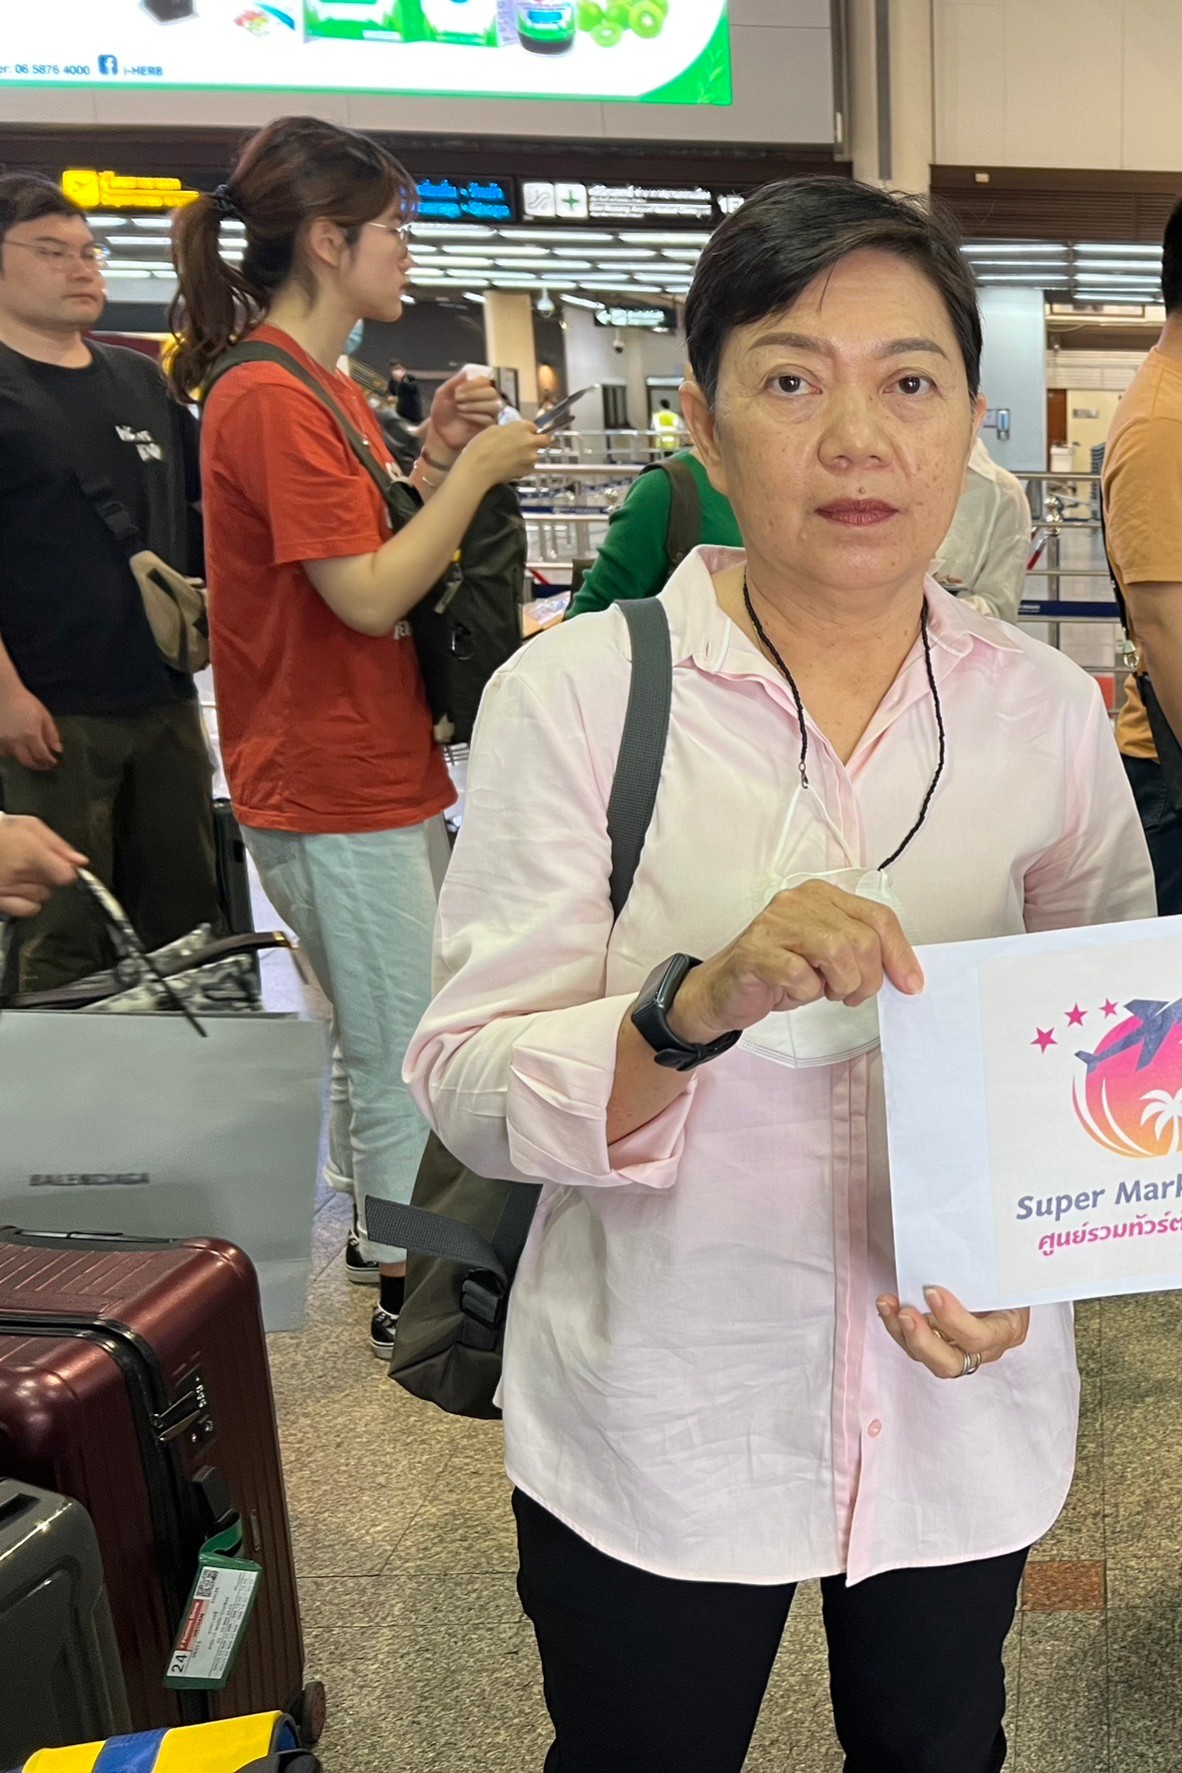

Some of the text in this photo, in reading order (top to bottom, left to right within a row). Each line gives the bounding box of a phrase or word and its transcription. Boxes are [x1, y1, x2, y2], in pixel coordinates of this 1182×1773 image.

[15, 64, 29, 75] 06
[32, 65, 60, 75] 5876
[63, 65, 91, 76] 4000
[1015, 1186, 1106, 1222] Super
[170, 1653, 189, 1674] 24
